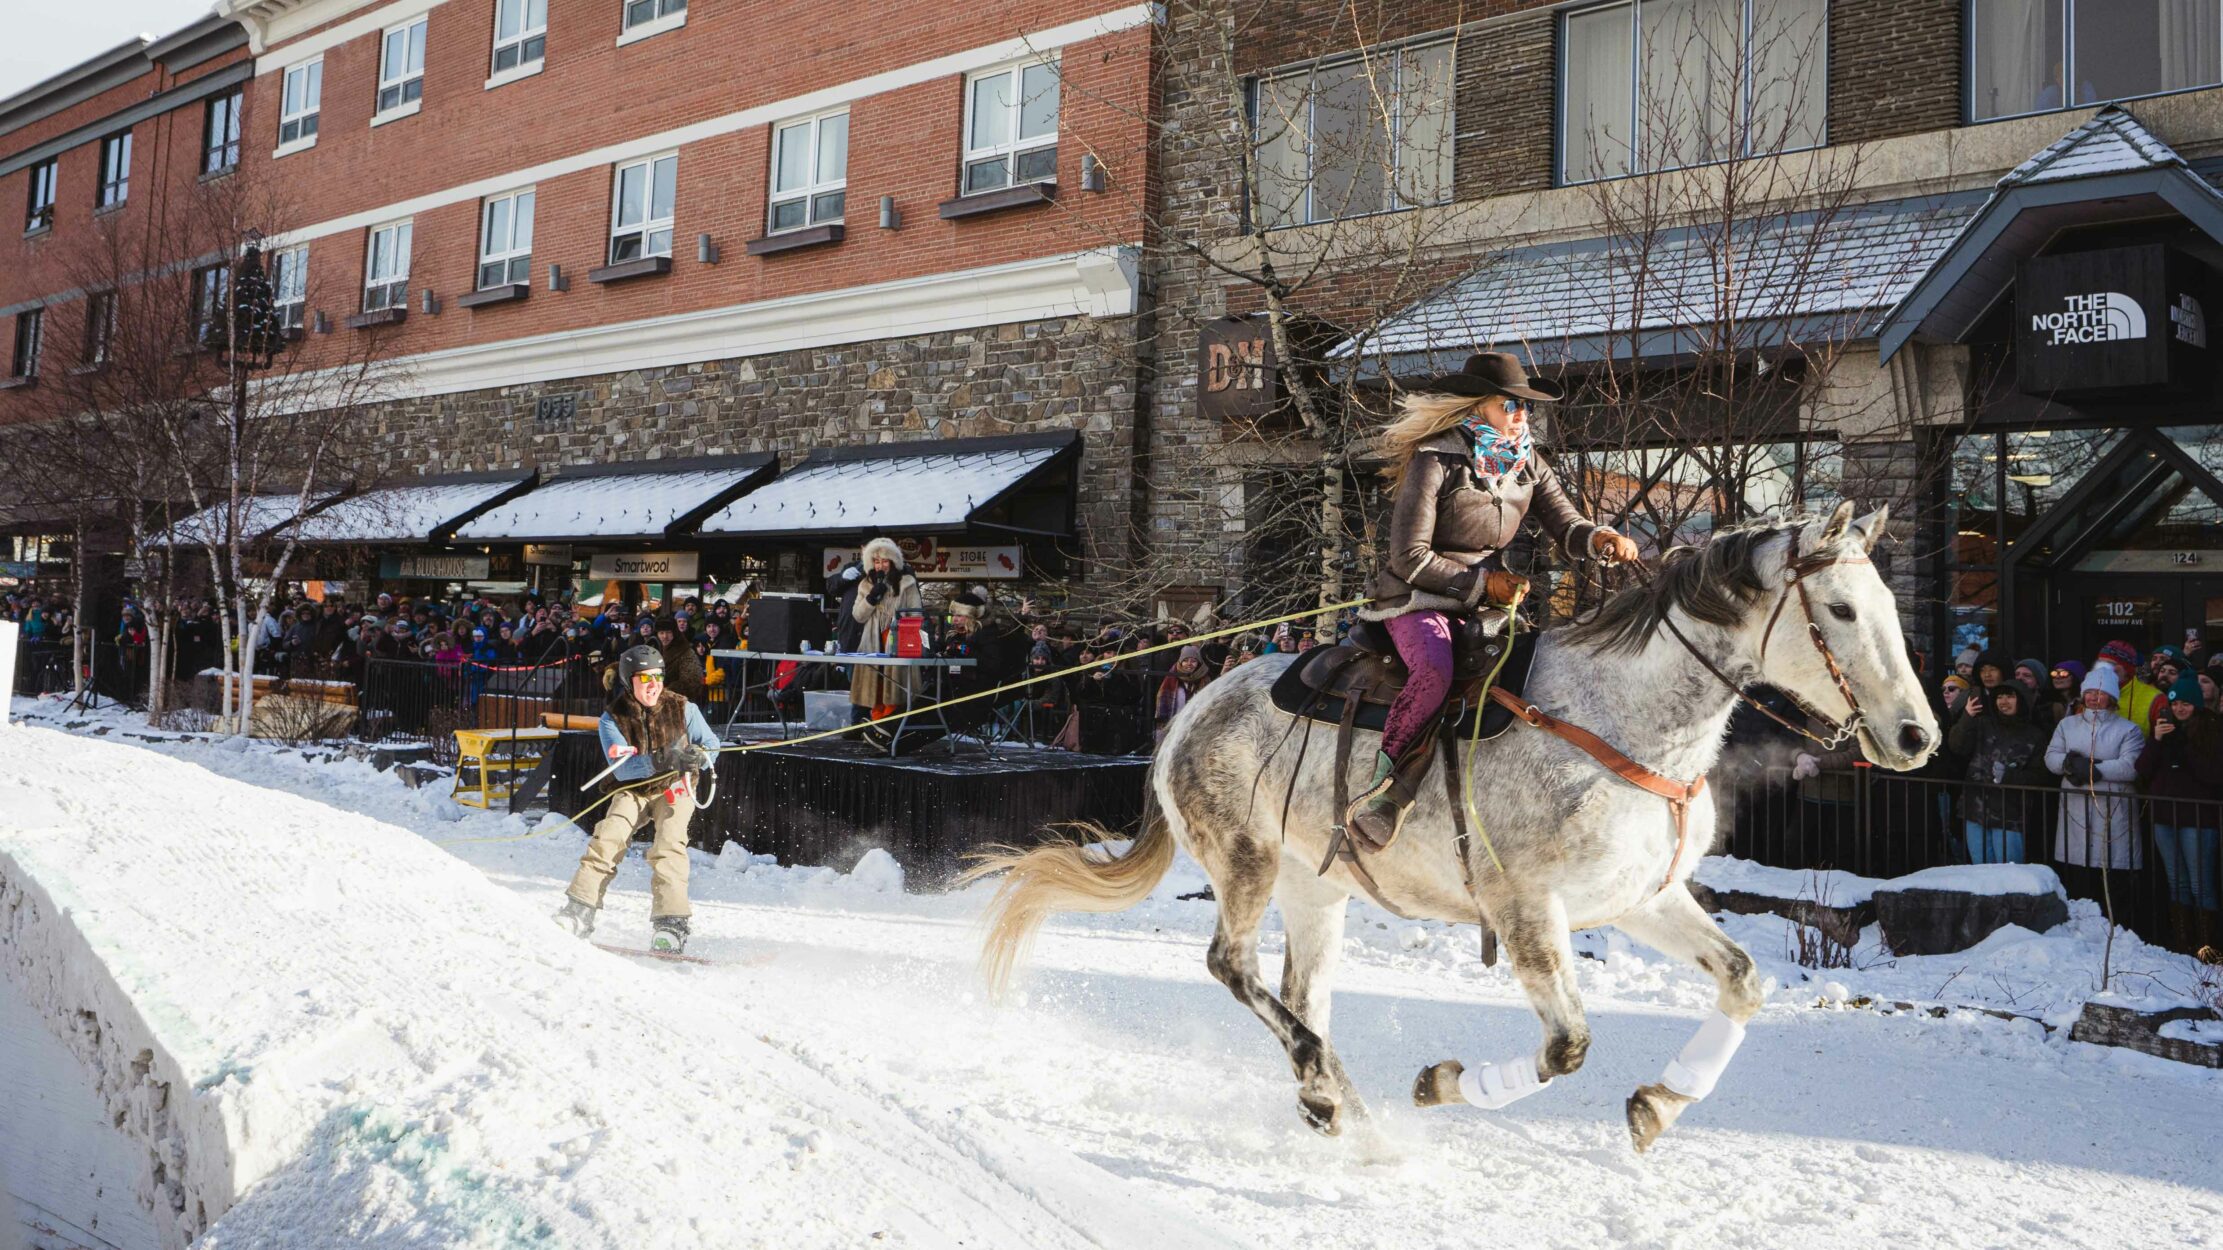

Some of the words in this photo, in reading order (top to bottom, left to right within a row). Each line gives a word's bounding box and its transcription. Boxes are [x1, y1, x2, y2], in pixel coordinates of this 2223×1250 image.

[2064, 293, 2106, 312] THE
[2032, 309, 2106, 331] NORTH
[2054, 326, 2106, 345] FACE
[536, 396, 575, 421] 1955
[614, 557, 670, 573] Smartwool
[960, 551, 987, 562] STORE
[2174, 552, 2196, 564] 124
[416, 557, 436, 577] BLUE
[2107, 601, 2134, 616] 102
